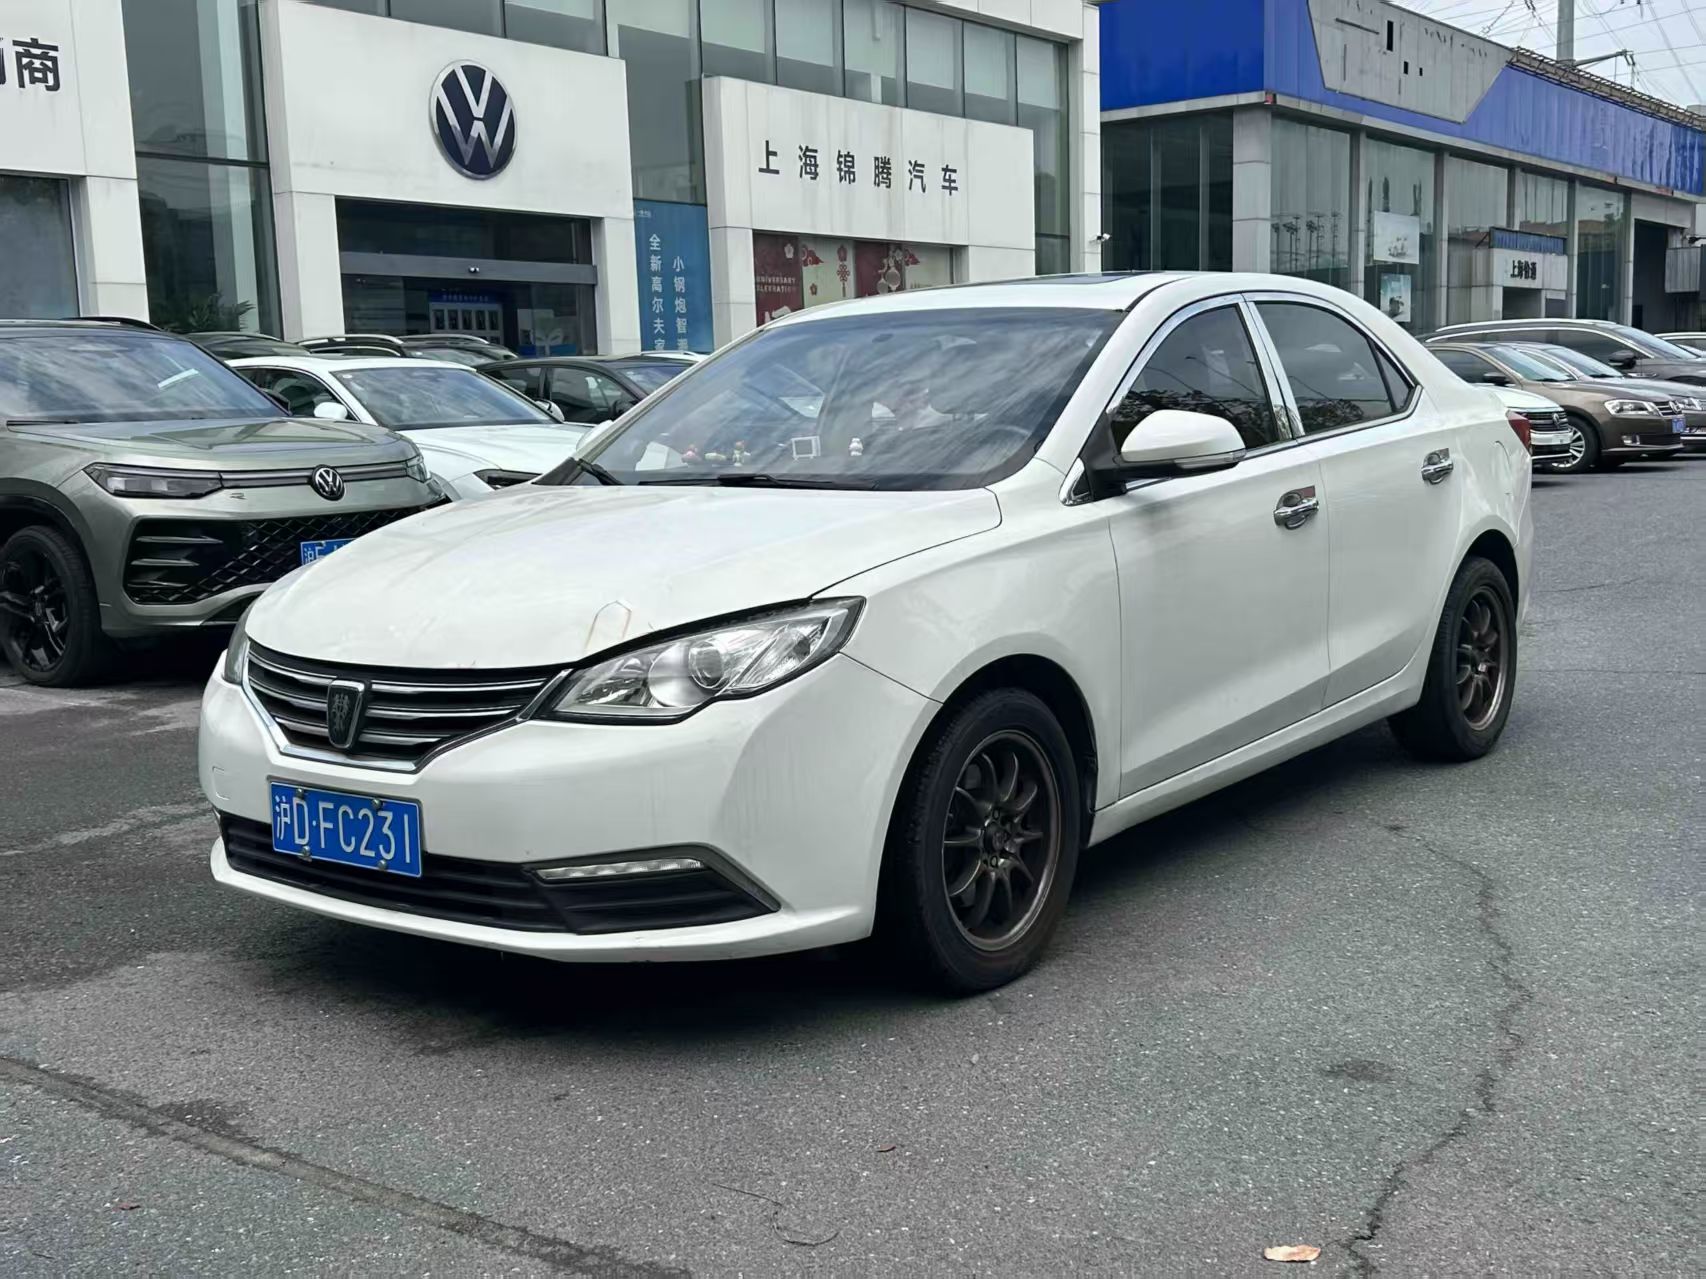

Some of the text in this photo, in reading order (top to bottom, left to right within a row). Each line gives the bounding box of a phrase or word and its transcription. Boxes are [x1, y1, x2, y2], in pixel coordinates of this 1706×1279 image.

[0, 37, 60, 91] 商
[758, 140, 959, 196] 上海锦腾汽车
[275, 795, 411, 864] 沪D·FC231
